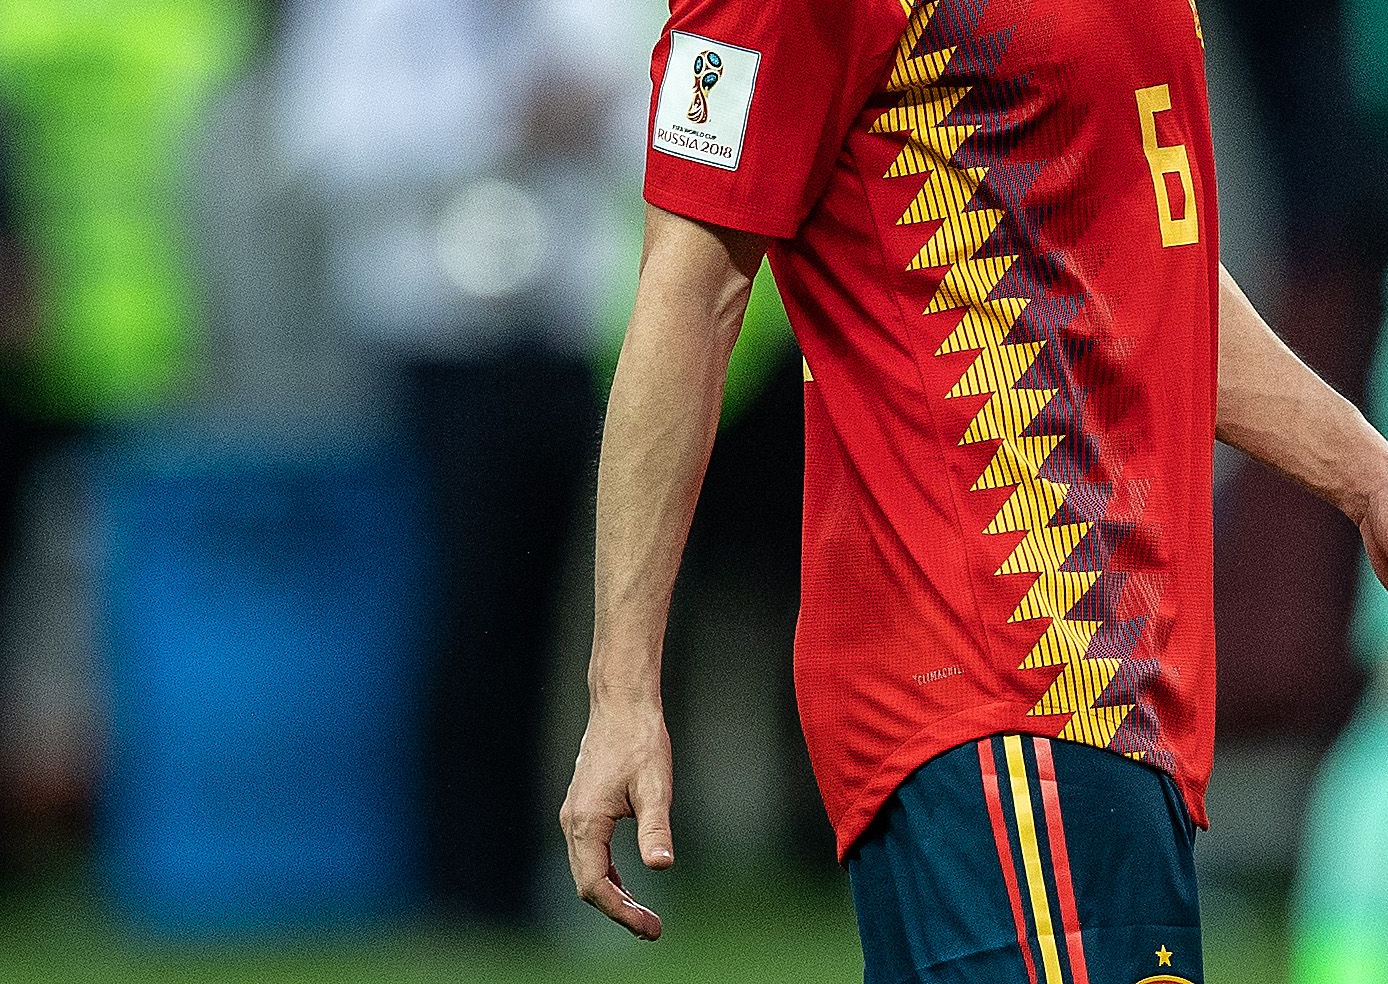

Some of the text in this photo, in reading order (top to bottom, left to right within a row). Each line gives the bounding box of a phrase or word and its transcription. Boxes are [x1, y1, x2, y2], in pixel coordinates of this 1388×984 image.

[657, 128, 733, 159] RUSSIA 2018
[1135, 84, 1199, 248] 6
